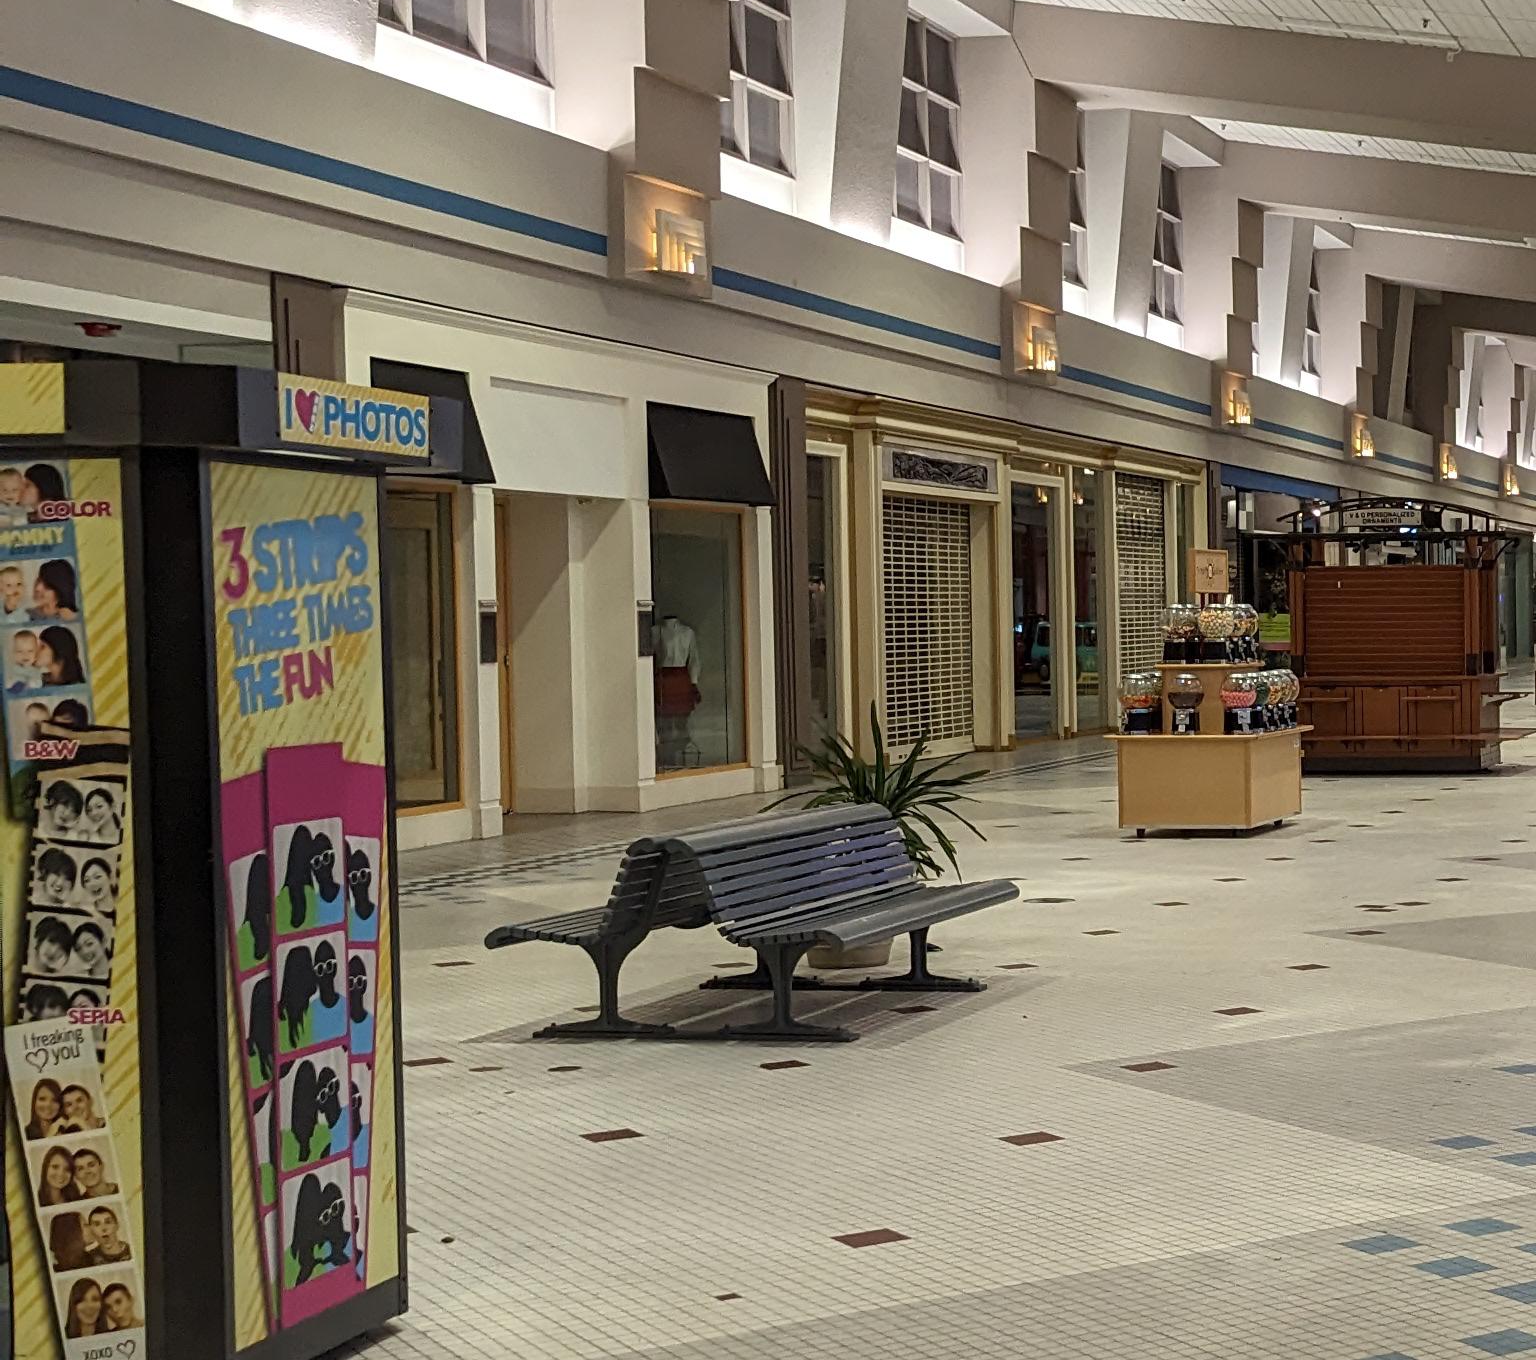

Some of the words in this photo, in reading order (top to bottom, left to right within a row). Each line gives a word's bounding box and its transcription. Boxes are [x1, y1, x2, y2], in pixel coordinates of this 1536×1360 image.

[285, 387, 293, 430] I
[324, 394, 427, 447] PHOTOS
[40, 501, 112, 518] COLOR
[221, 526, 249, 599] 3
[252, 511, 368, 593] STRIPS
[233, 658, 285, 717] THE
[283, 646, 335, 705] FUN
[24, 740, 78, 759] B&W
[67, 1008, 127, 1025] SEPIA
[31, 1028, 85, 1048] freaking
[51, 1043, 80, 1066] you
